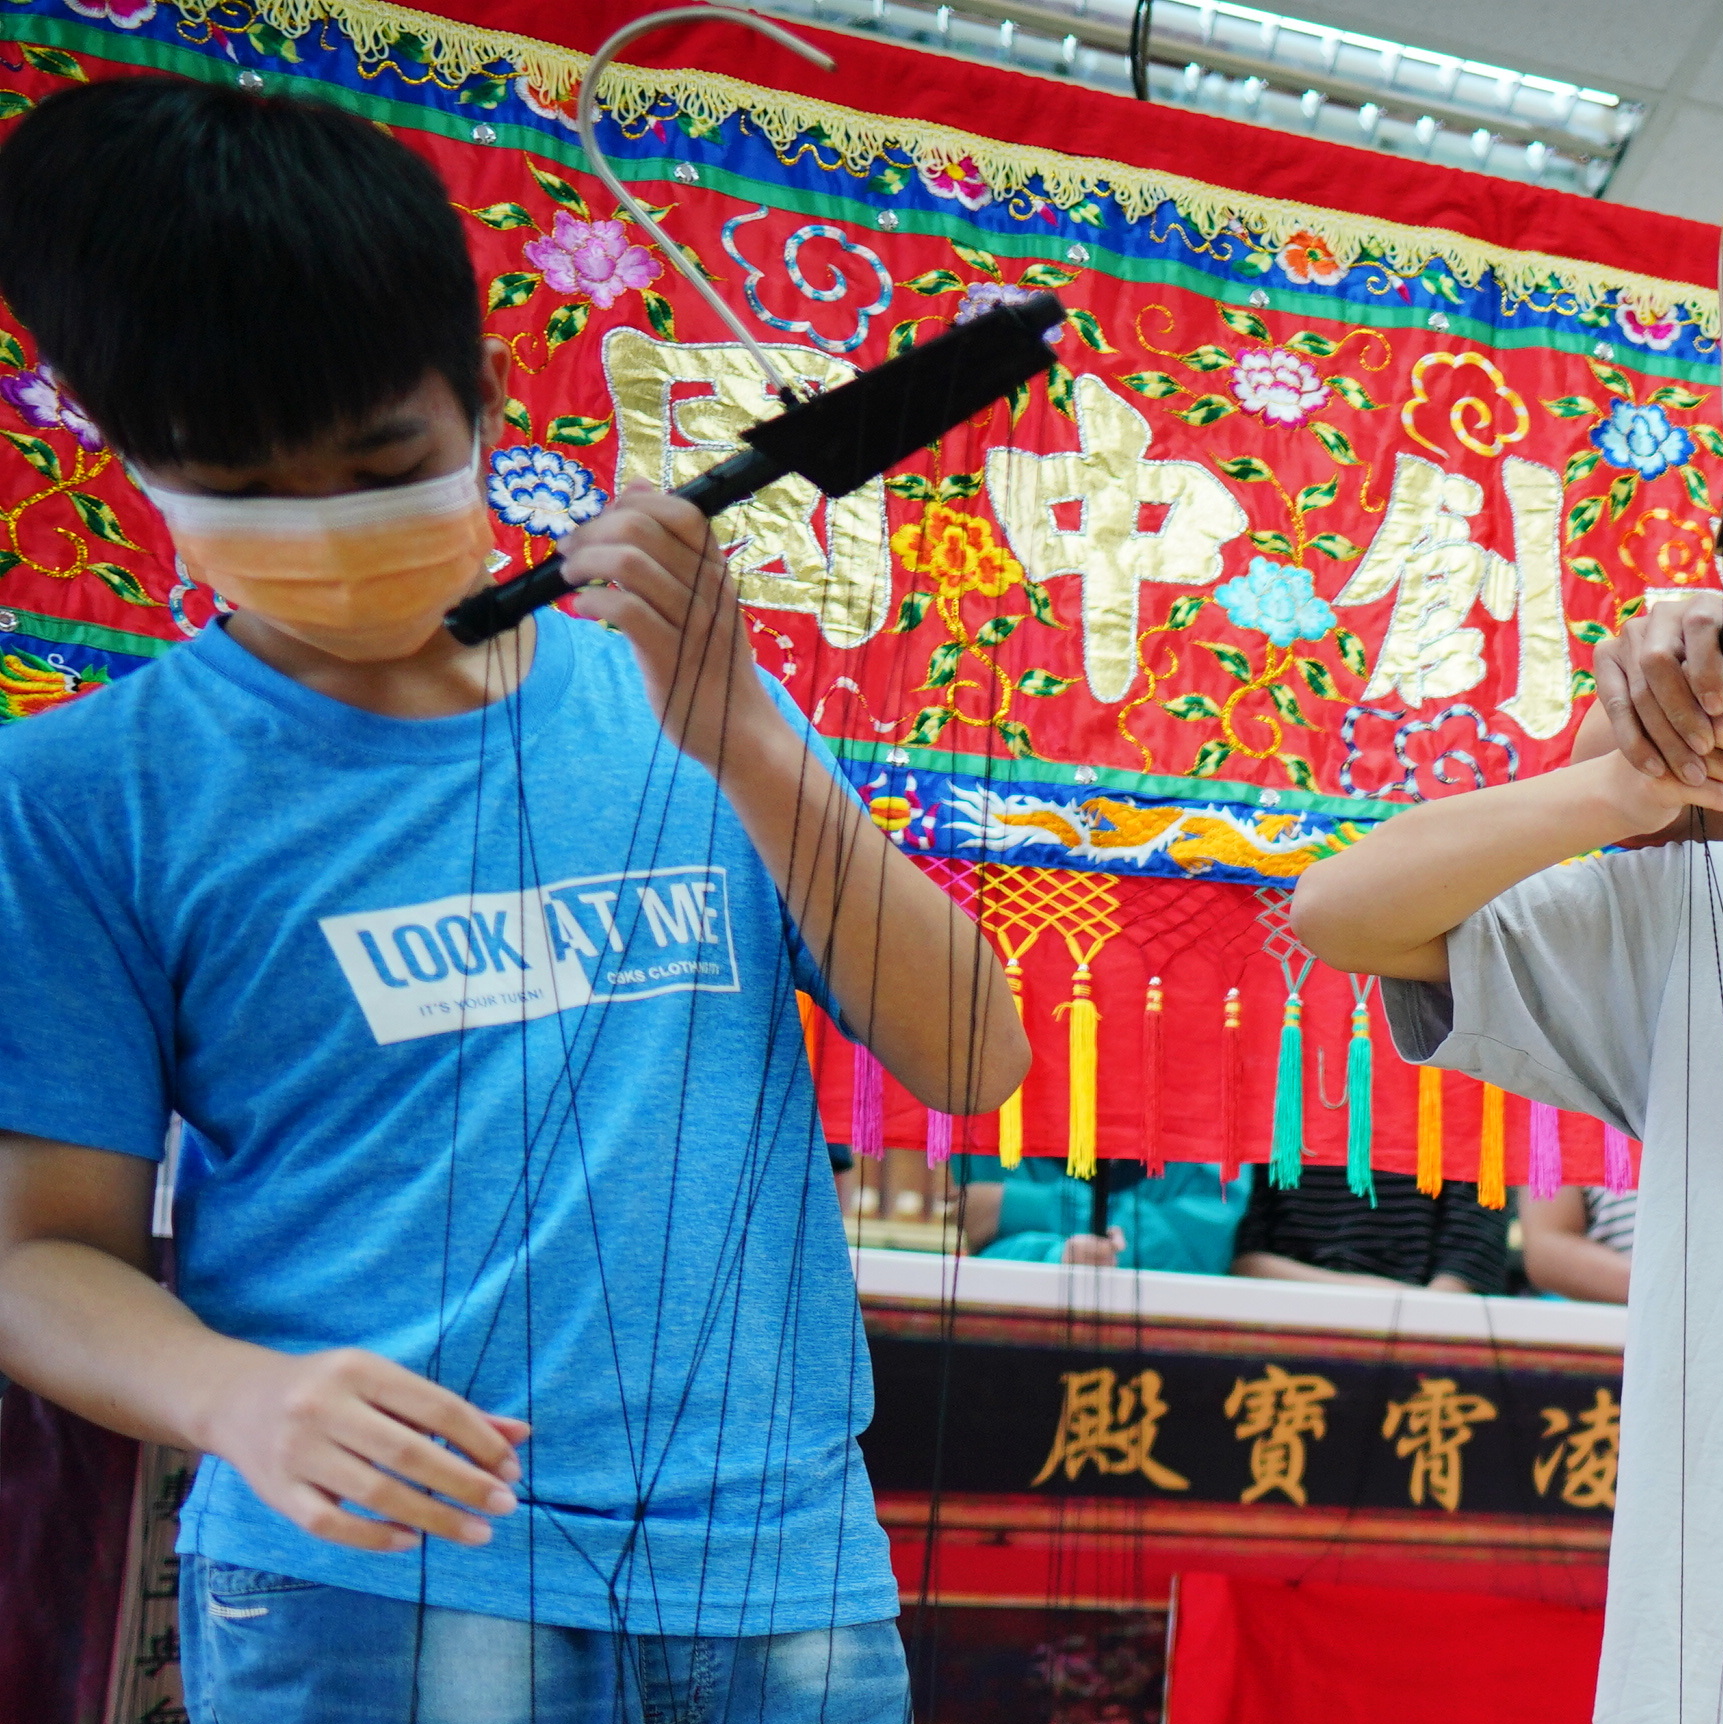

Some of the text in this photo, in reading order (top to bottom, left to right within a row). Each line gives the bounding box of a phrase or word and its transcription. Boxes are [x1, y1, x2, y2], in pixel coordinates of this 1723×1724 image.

[357, 882, 720, 988] LOOK AT ME
[455, 994, 498, 1010] YOUR
